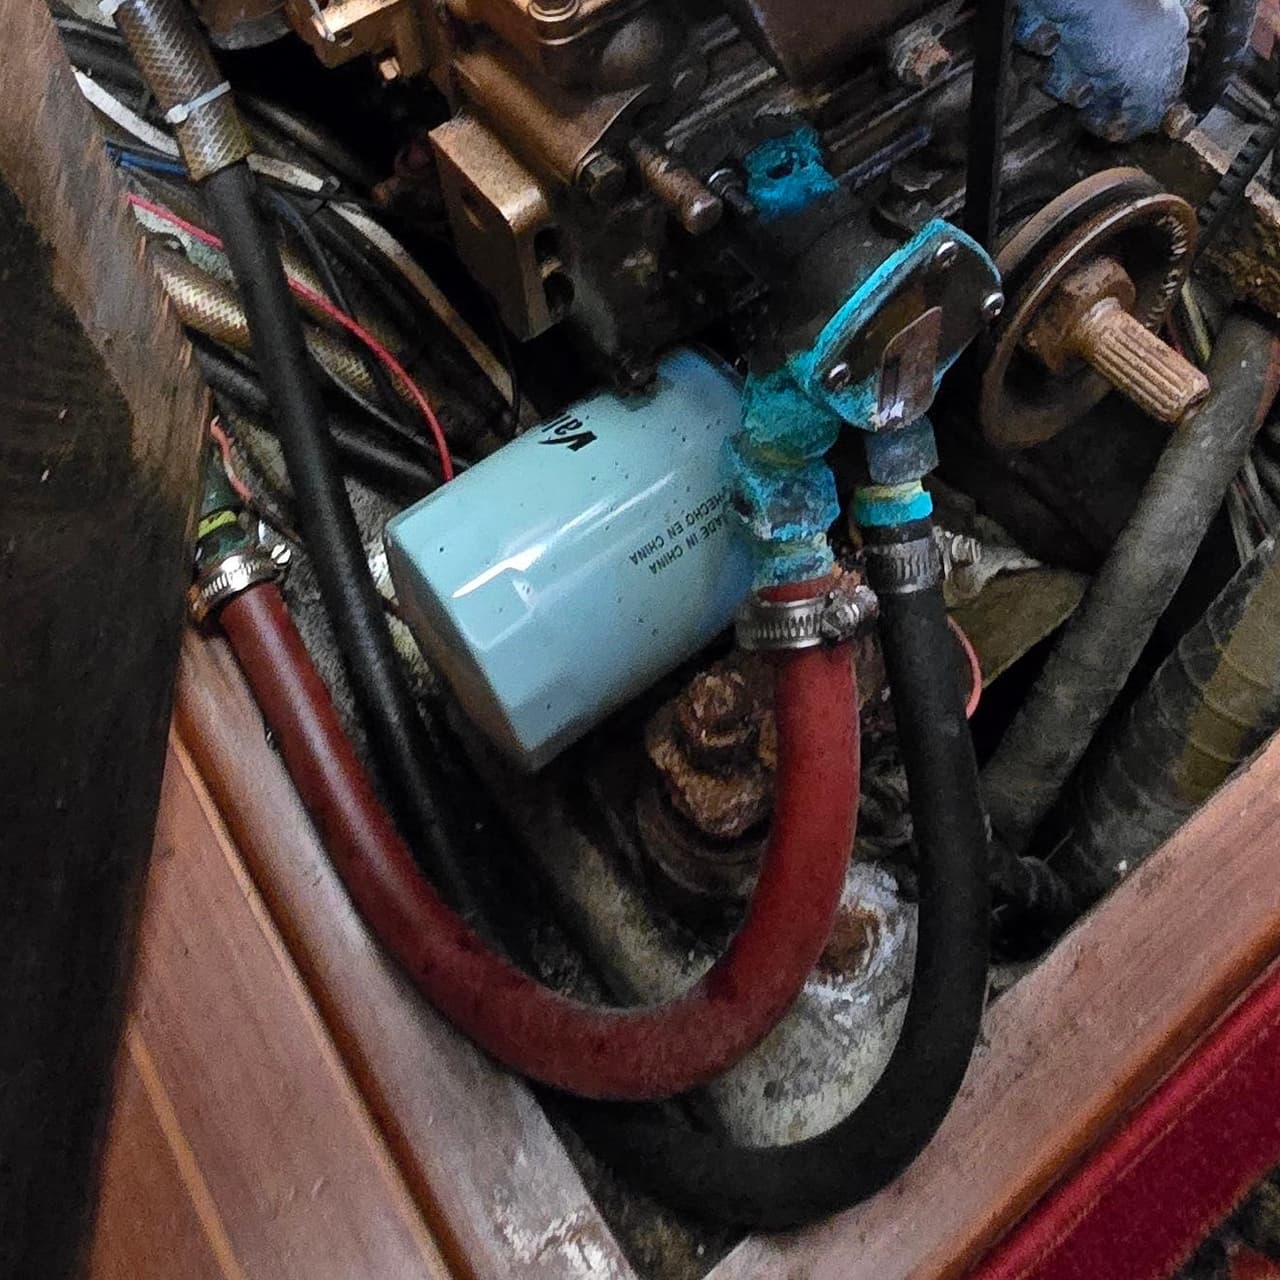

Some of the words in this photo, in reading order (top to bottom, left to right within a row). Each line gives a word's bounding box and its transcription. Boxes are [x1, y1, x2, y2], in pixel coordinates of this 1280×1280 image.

[684, 492, 726, 527] HECHO
[666, 520, 685, 540] EN
[685, 532, 700, 550] IN
[628, 535, 665, 566] CHINA
[648, 544, 684, 575] CHINA
